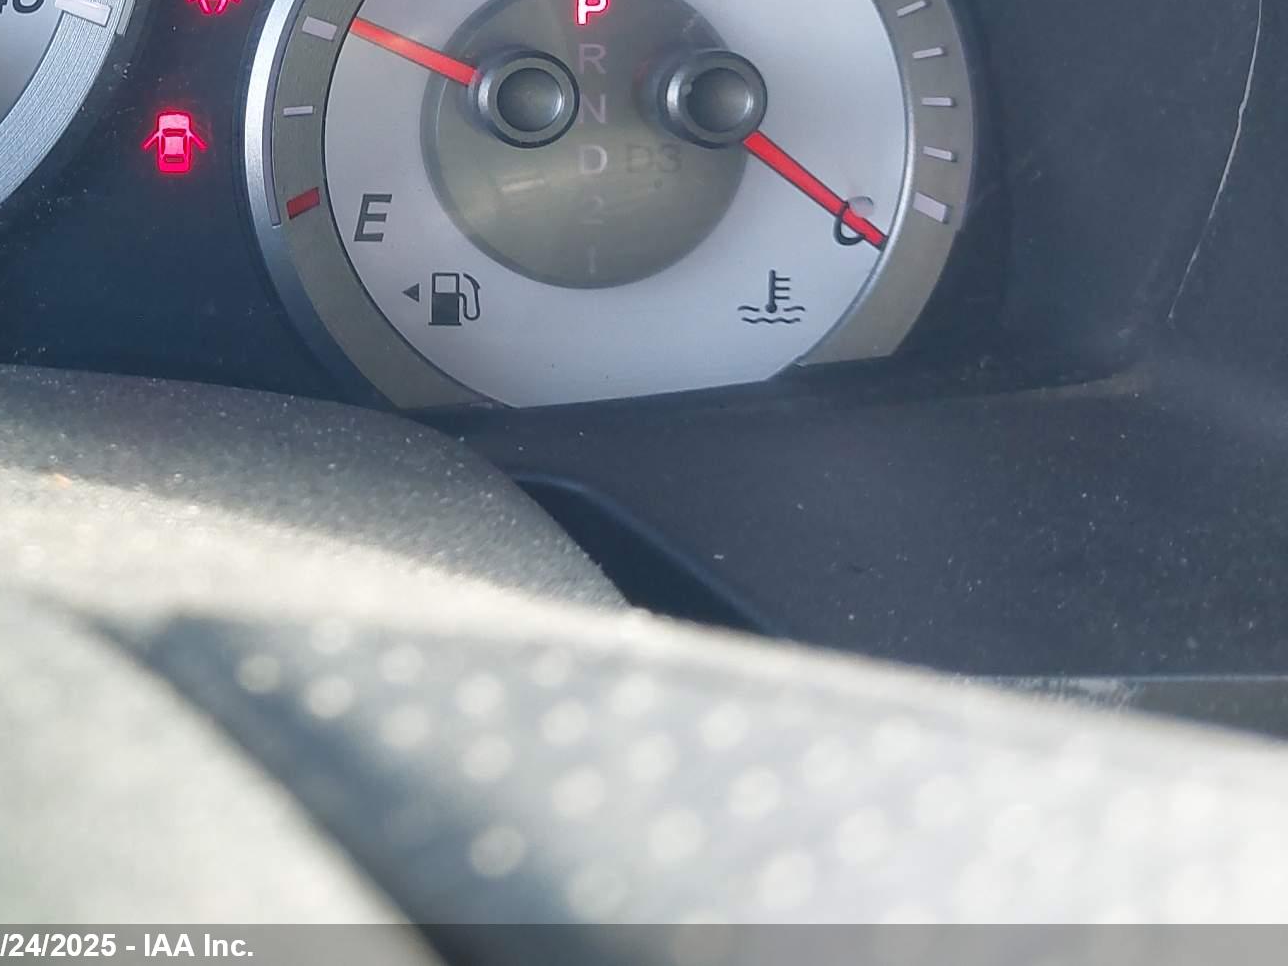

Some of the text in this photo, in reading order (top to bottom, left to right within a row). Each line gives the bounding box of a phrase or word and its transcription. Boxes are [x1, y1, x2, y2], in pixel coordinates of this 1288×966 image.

[578, 43, 608, 74] R
[578, 94, 607, 124] N
[578, 145, 609, 175] D
[353, 194, 393, 242] E
